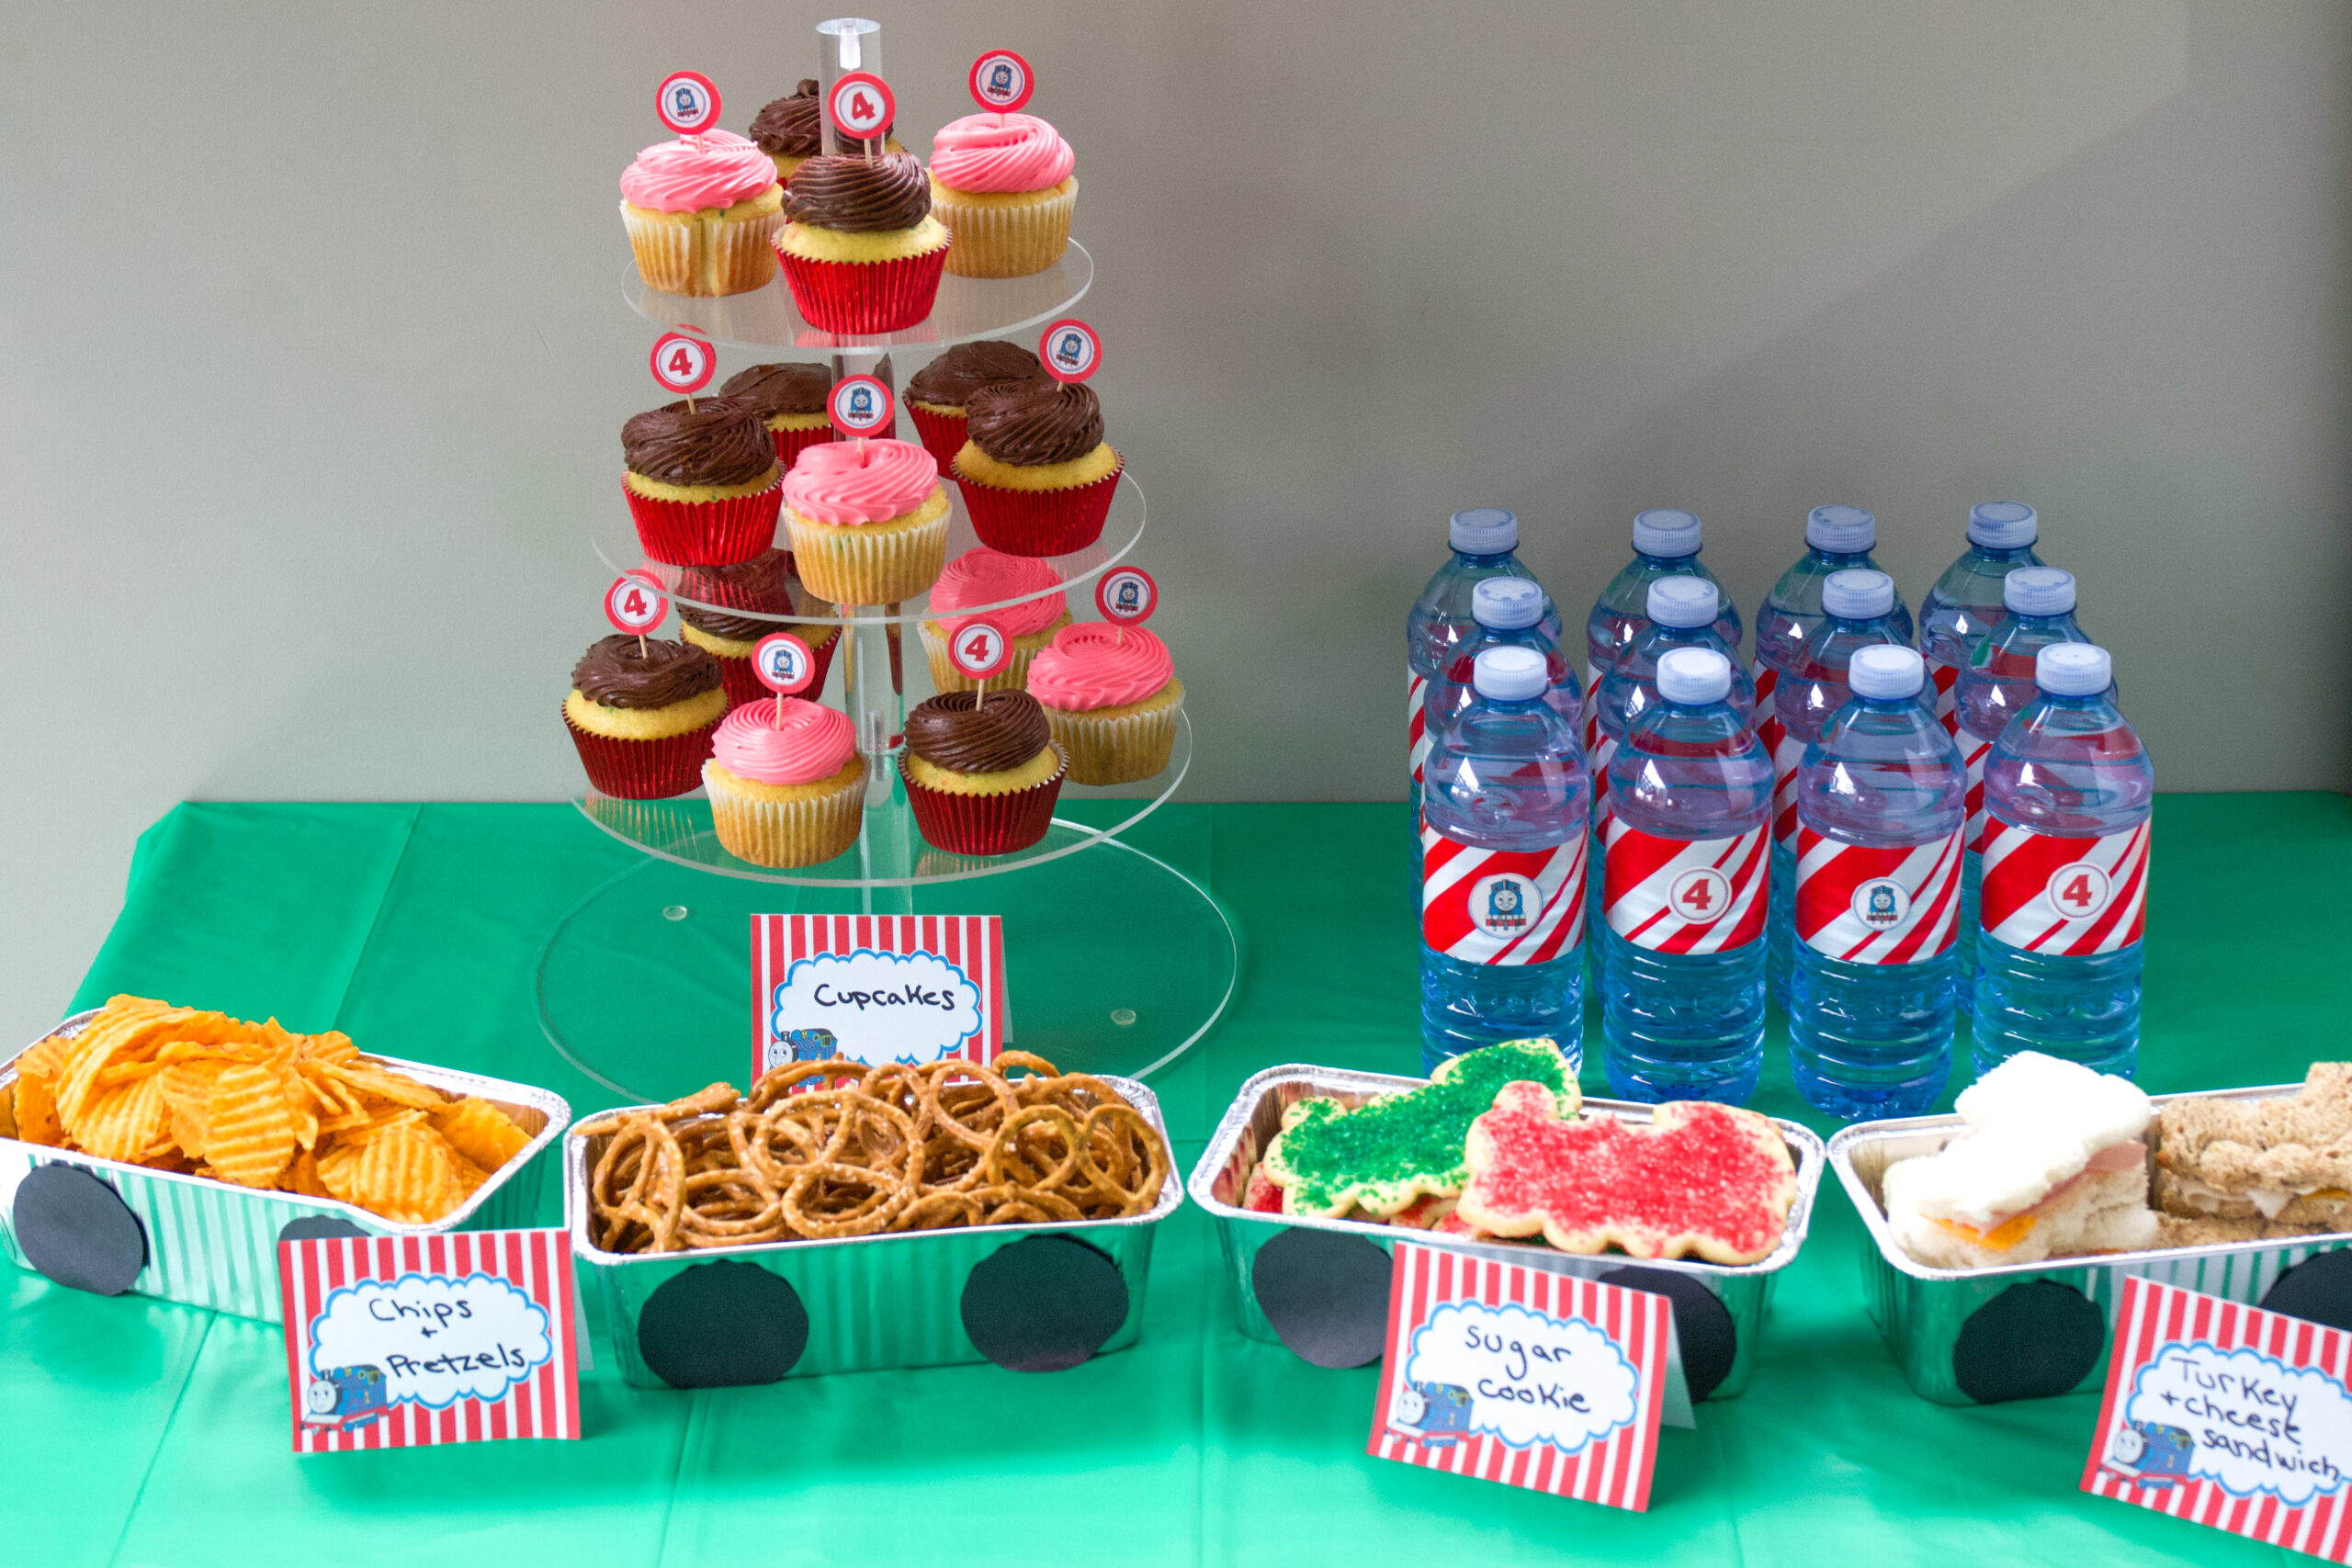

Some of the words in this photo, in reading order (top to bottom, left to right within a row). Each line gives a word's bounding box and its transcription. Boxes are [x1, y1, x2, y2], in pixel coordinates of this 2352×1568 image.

[851, 90, 876, 120] 4
[668, 347, 694, 377] 4
[623, 588, 648, 617] 4
[964, 634, 989, 662] 4
[1681, 878, 1713, 910] 4
[2062, 874, 2092, 907] 4
[368, 1297, 473, 1328] Chips
[385, 1342, 526, 1378] Pretzels
